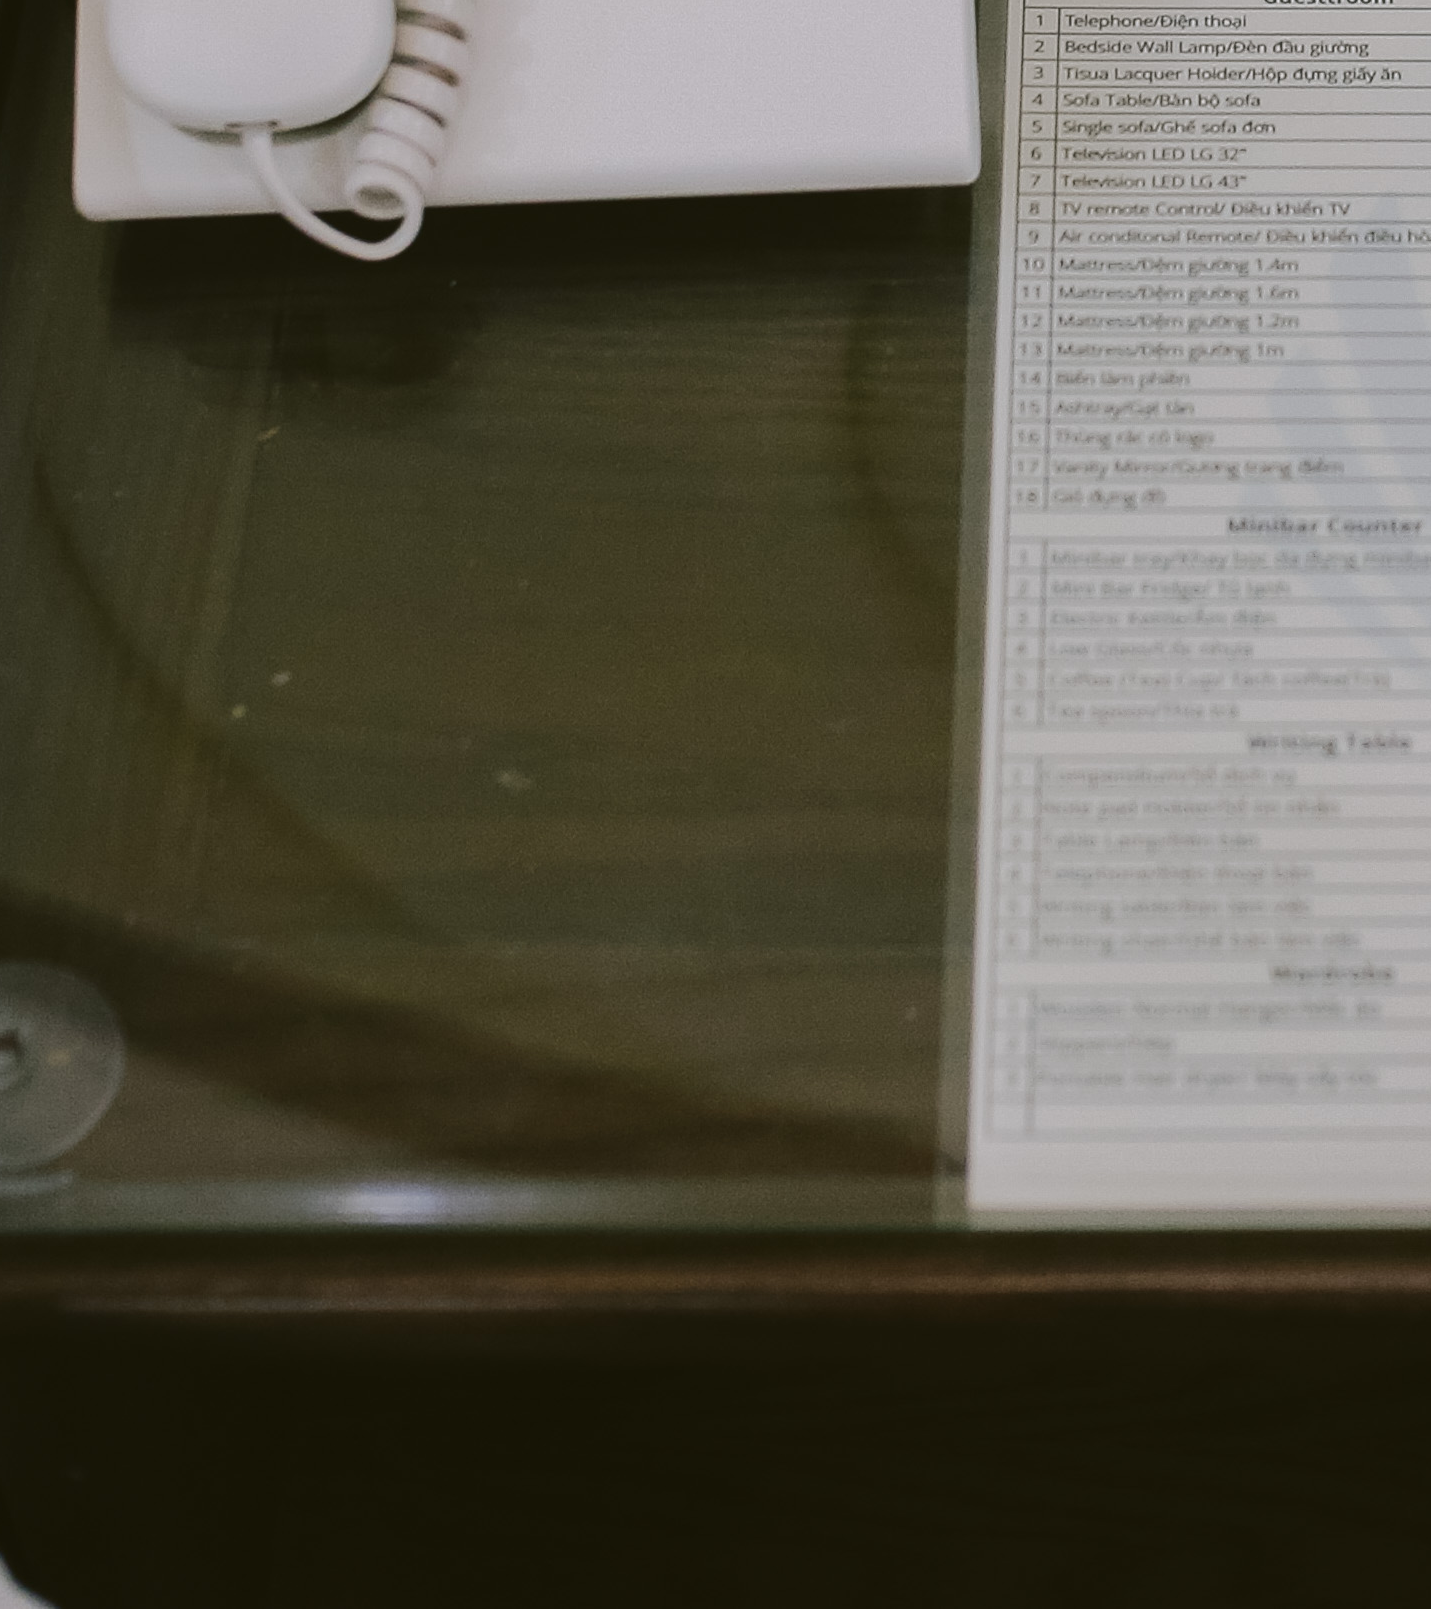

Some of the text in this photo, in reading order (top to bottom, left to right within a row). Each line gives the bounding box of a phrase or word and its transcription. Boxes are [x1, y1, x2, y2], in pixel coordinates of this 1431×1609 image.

[1037, 15, 1043, 26] 1
[1034, 41, 1044, 53] 2
[1065, 40, 1133, 54] Bedside
[1137, 41, 1173, 54] Wall
[1033, 67, 1043, 80] 3
[1066, 68, 1109, 80] Tisua
[1114, 68, 1182, 83] Lacquer
